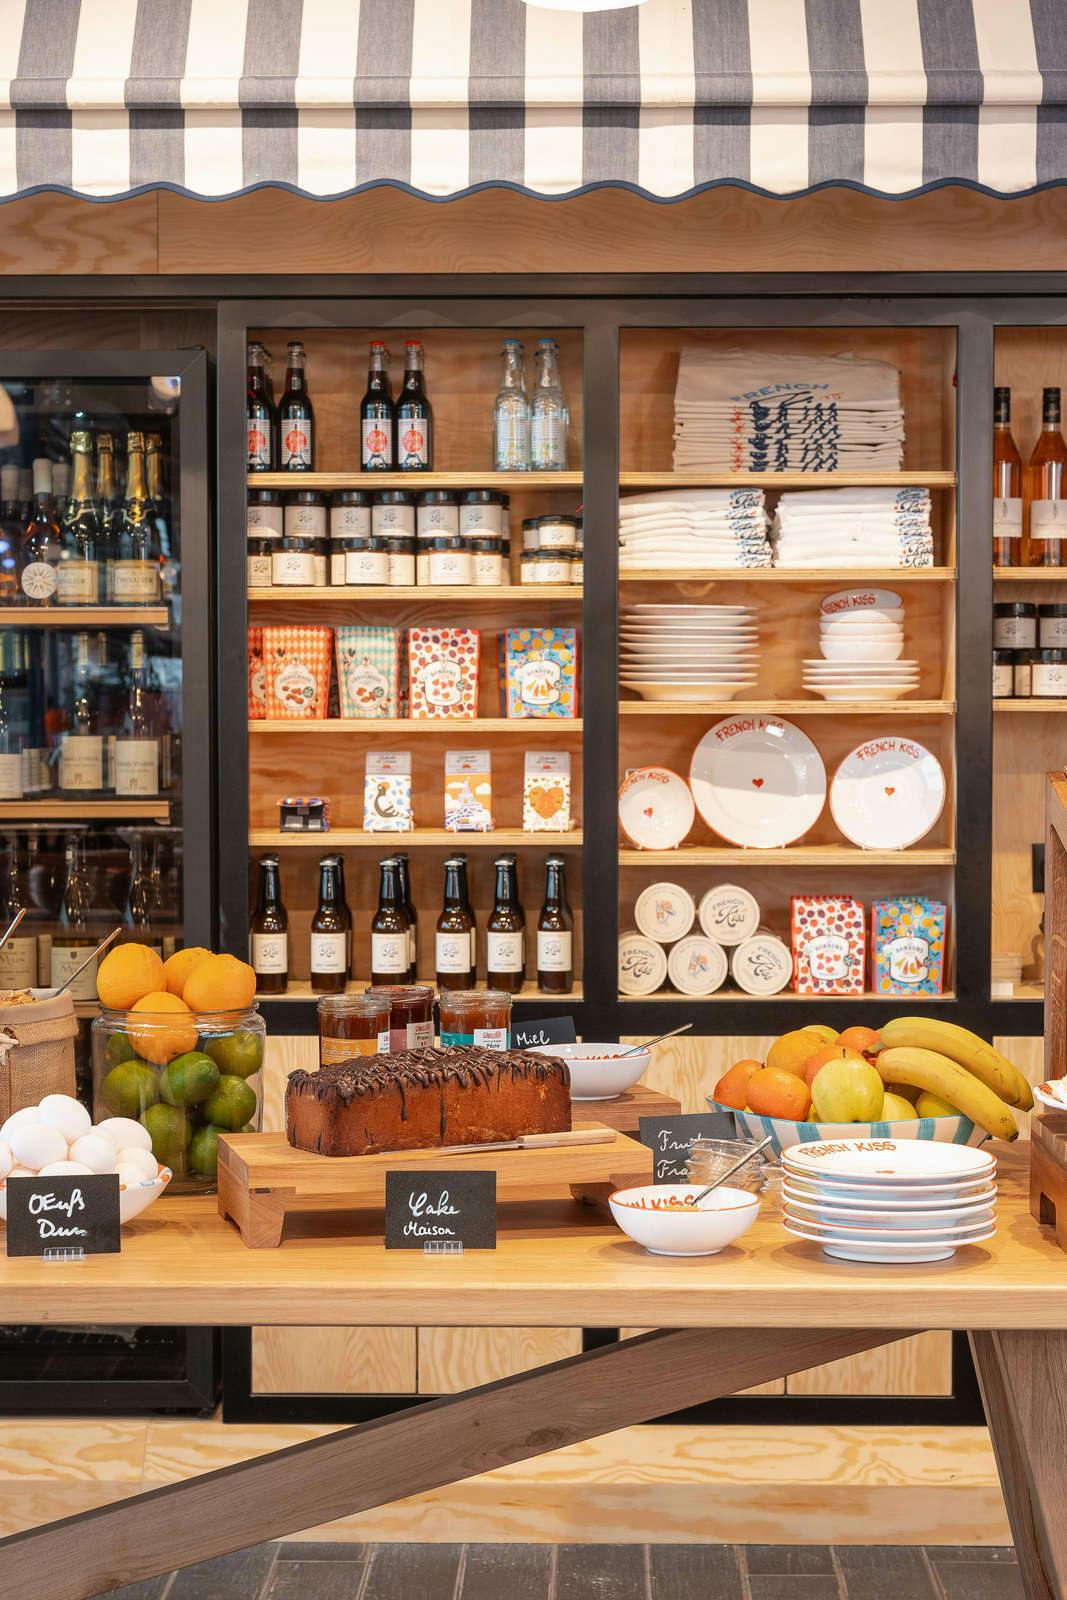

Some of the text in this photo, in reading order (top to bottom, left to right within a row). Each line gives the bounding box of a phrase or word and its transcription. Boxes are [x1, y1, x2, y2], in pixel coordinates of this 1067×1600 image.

[715, 719, 755, 742] FRENCH
[855, 740, 920, 761] FRENCH KISS
[516, 1030, 550, 1046] Miel
[797, 1141, 897, 1159] FRENCH KISS
[656, 1159, 689, 1179] Fra
[408, 1190, 462, 1217] Cake
[403, 1220, 456, 1237] Maison
